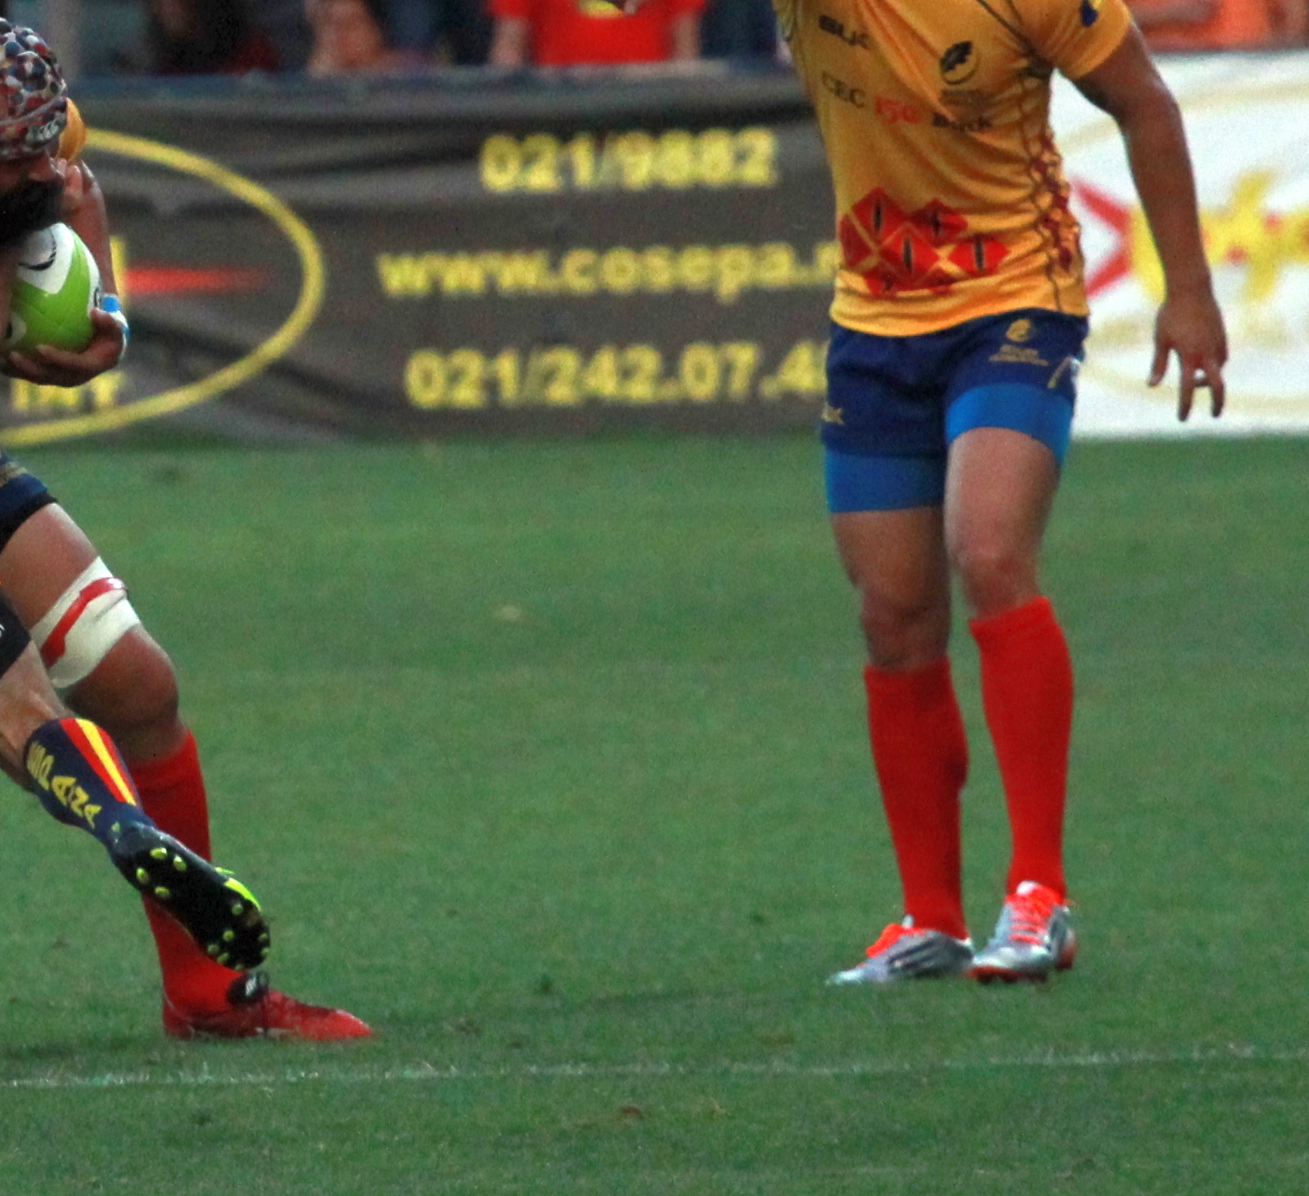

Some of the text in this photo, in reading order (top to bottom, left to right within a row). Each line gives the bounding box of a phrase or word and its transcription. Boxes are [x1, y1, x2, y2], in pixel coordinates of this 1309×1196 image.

[482, 127, 778, 195] 021/9882
[377, 241, 841, 304] www.cosepa.r
[403, 339, 829, 410] 021/242.07.4
